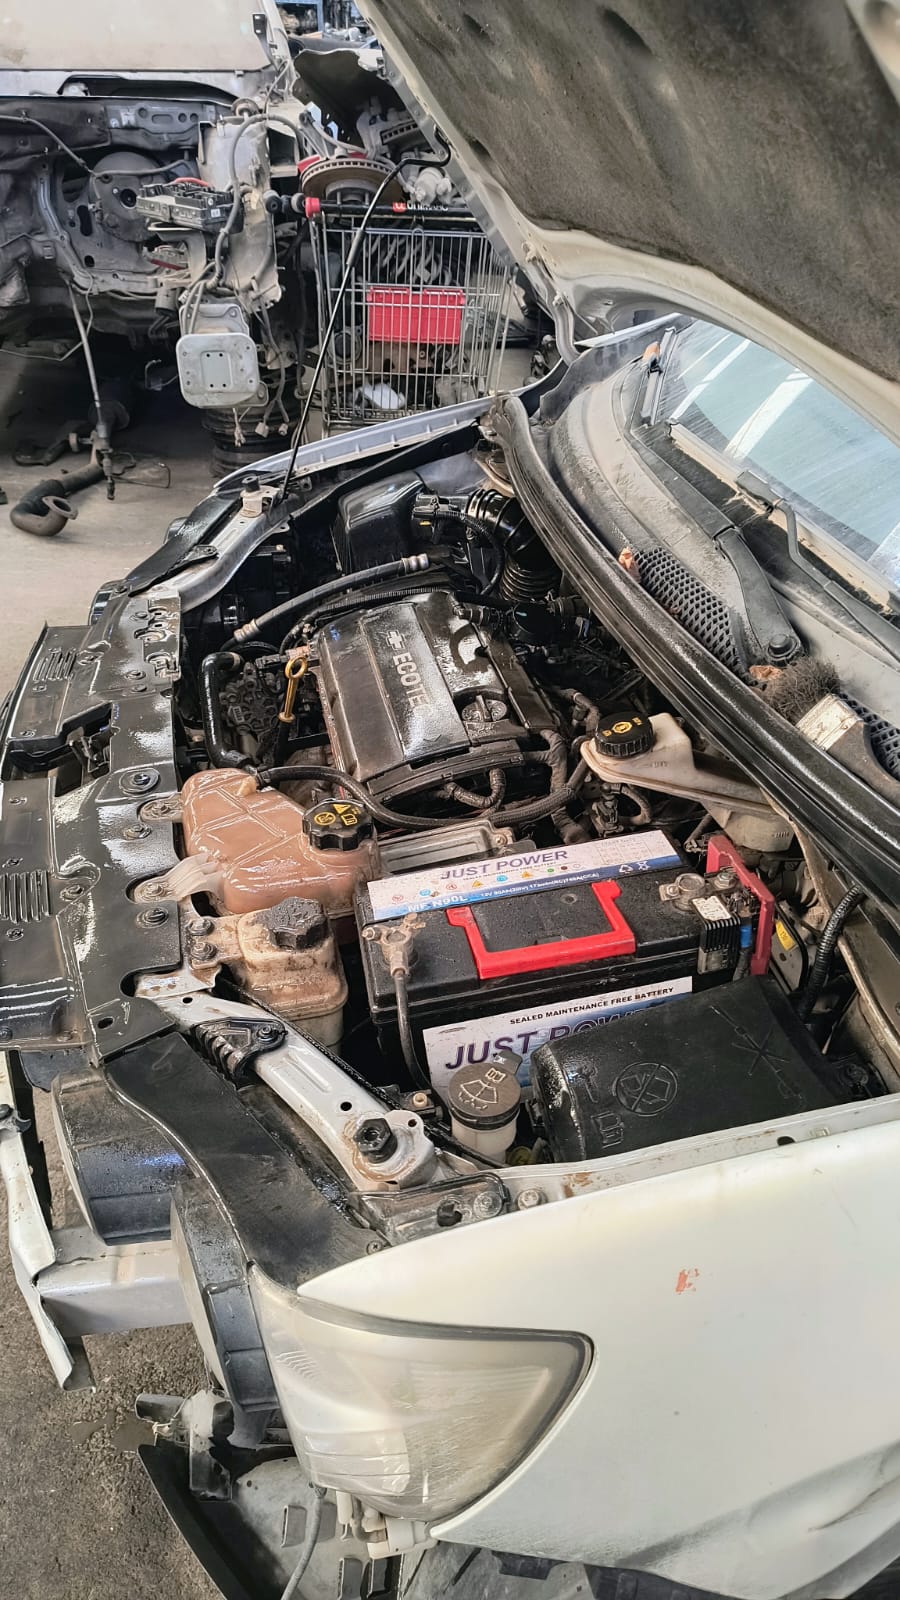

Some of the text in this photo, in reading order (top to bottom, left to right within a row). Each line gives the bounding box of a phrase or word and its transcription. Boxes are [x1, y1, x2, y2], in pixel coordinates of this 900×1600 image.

[441, 864, 490, 880] JUST
[496, 852, 568, 871] POWER
[510, 987, 674, 1024] SEALED MAINTENANCE FREE BATTERY
